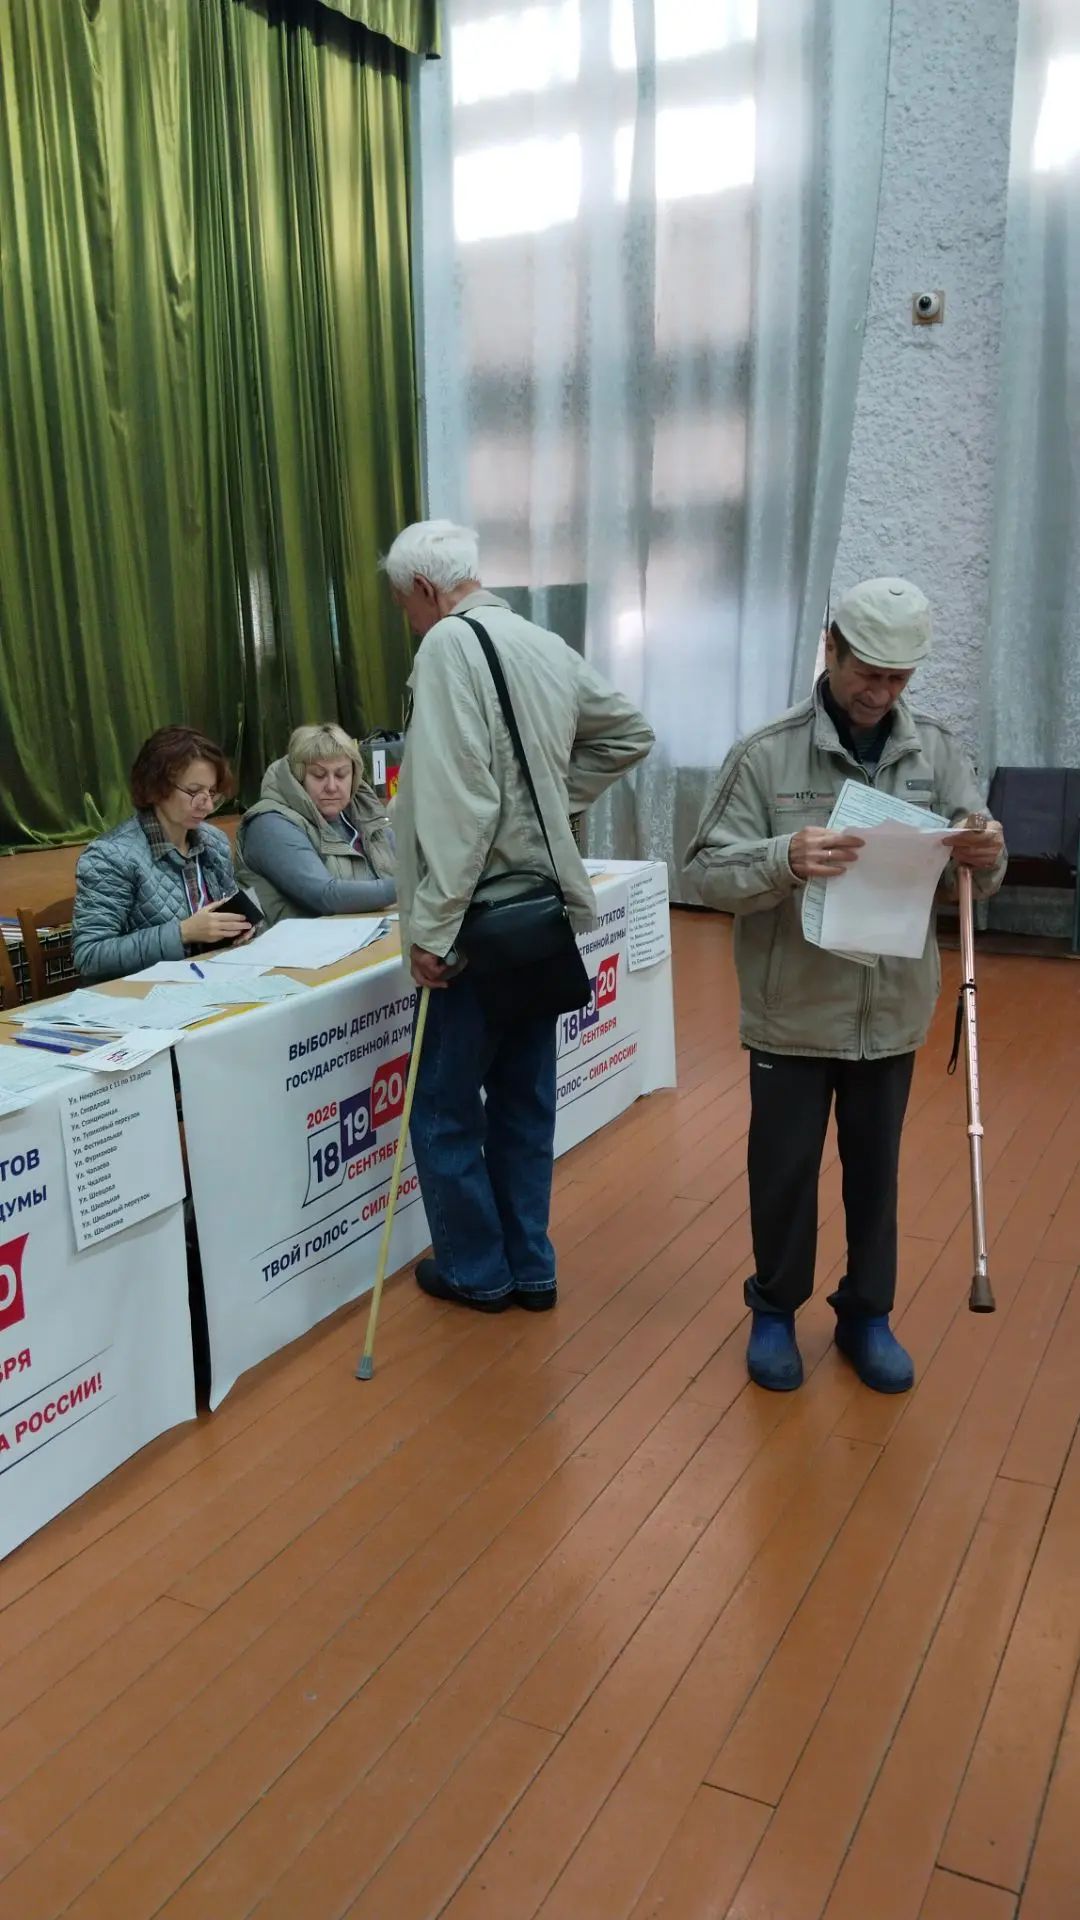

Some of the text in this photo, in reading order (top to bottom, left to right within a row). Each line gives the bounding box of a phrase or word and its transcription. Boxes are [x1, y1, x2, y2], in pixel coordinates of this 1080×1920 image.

[610, 928, 627, 945] ДУМЫ
[598, 967, 616, 999] 20
[289, 993, 417, 1061] ВЫБОРЫ ДЕПУТАТОВ
[563, 1014, 578, 1044] 18
[582, 1016, 617, 1046] СЕНТЯБРЯ
[286, 1023, 413, 1092] ГОСУДАРСТВЕННОЙ ДУМ
[556, 1076, 581, 1100] ГОЛОС
[589, 1060, 608, 1080] СИЛА
[609, 1043, 638, 1067] РОССИИ!
[374, 1072, 402, 1115] 20
[306, 1102, 337, 1129] 2026
[343, 1106, 369, 1147] 19
[313, 1141, 340, 1183] 18
[348, 1139, 400, 1180] СЕНТЯБР
[262, 1244, 301, 1282] ТВОЙ
[305, 1220, 348, 1257] ГОЛОС
[15, 1372, 102, 1444] РОССИИ!
